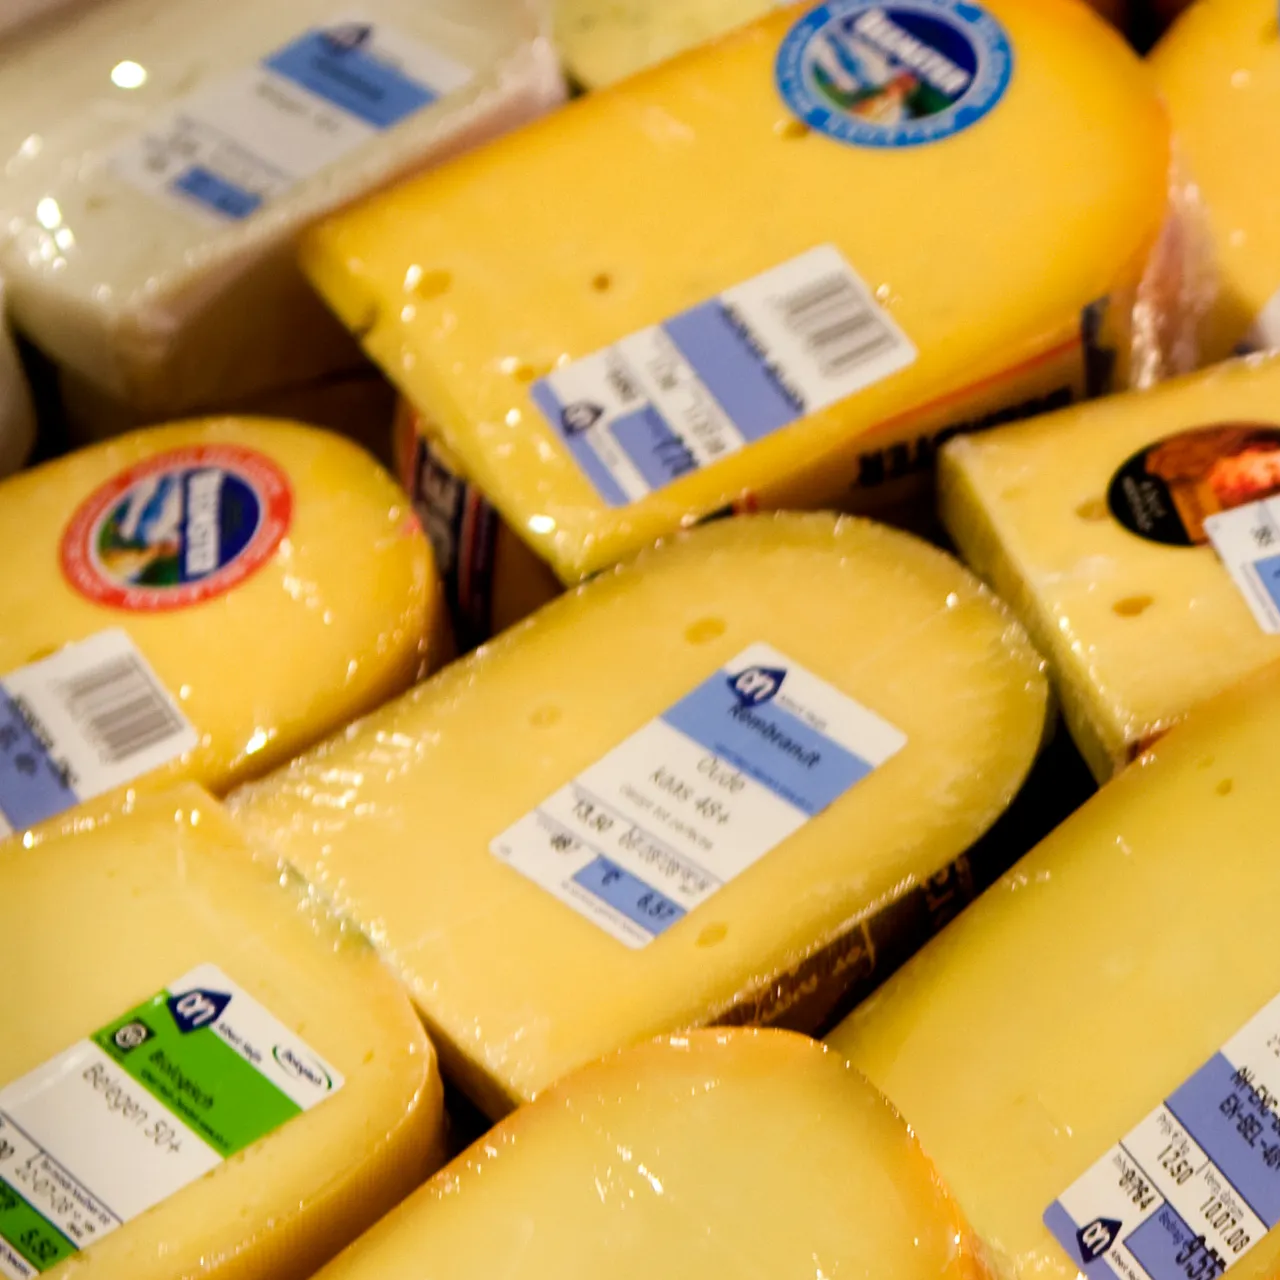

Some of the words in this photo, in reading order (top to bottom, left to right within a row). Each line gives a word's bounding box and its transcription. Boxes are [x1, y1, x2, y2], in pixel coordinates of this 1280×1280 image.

[723, 704, 823, 769] Rembrandt
[76, 1062, 157, 1127] Belegen
[1155, 1144, 1194, 1186] 12.50
[1198, 1195, 1250, 1253] 10.07.08
